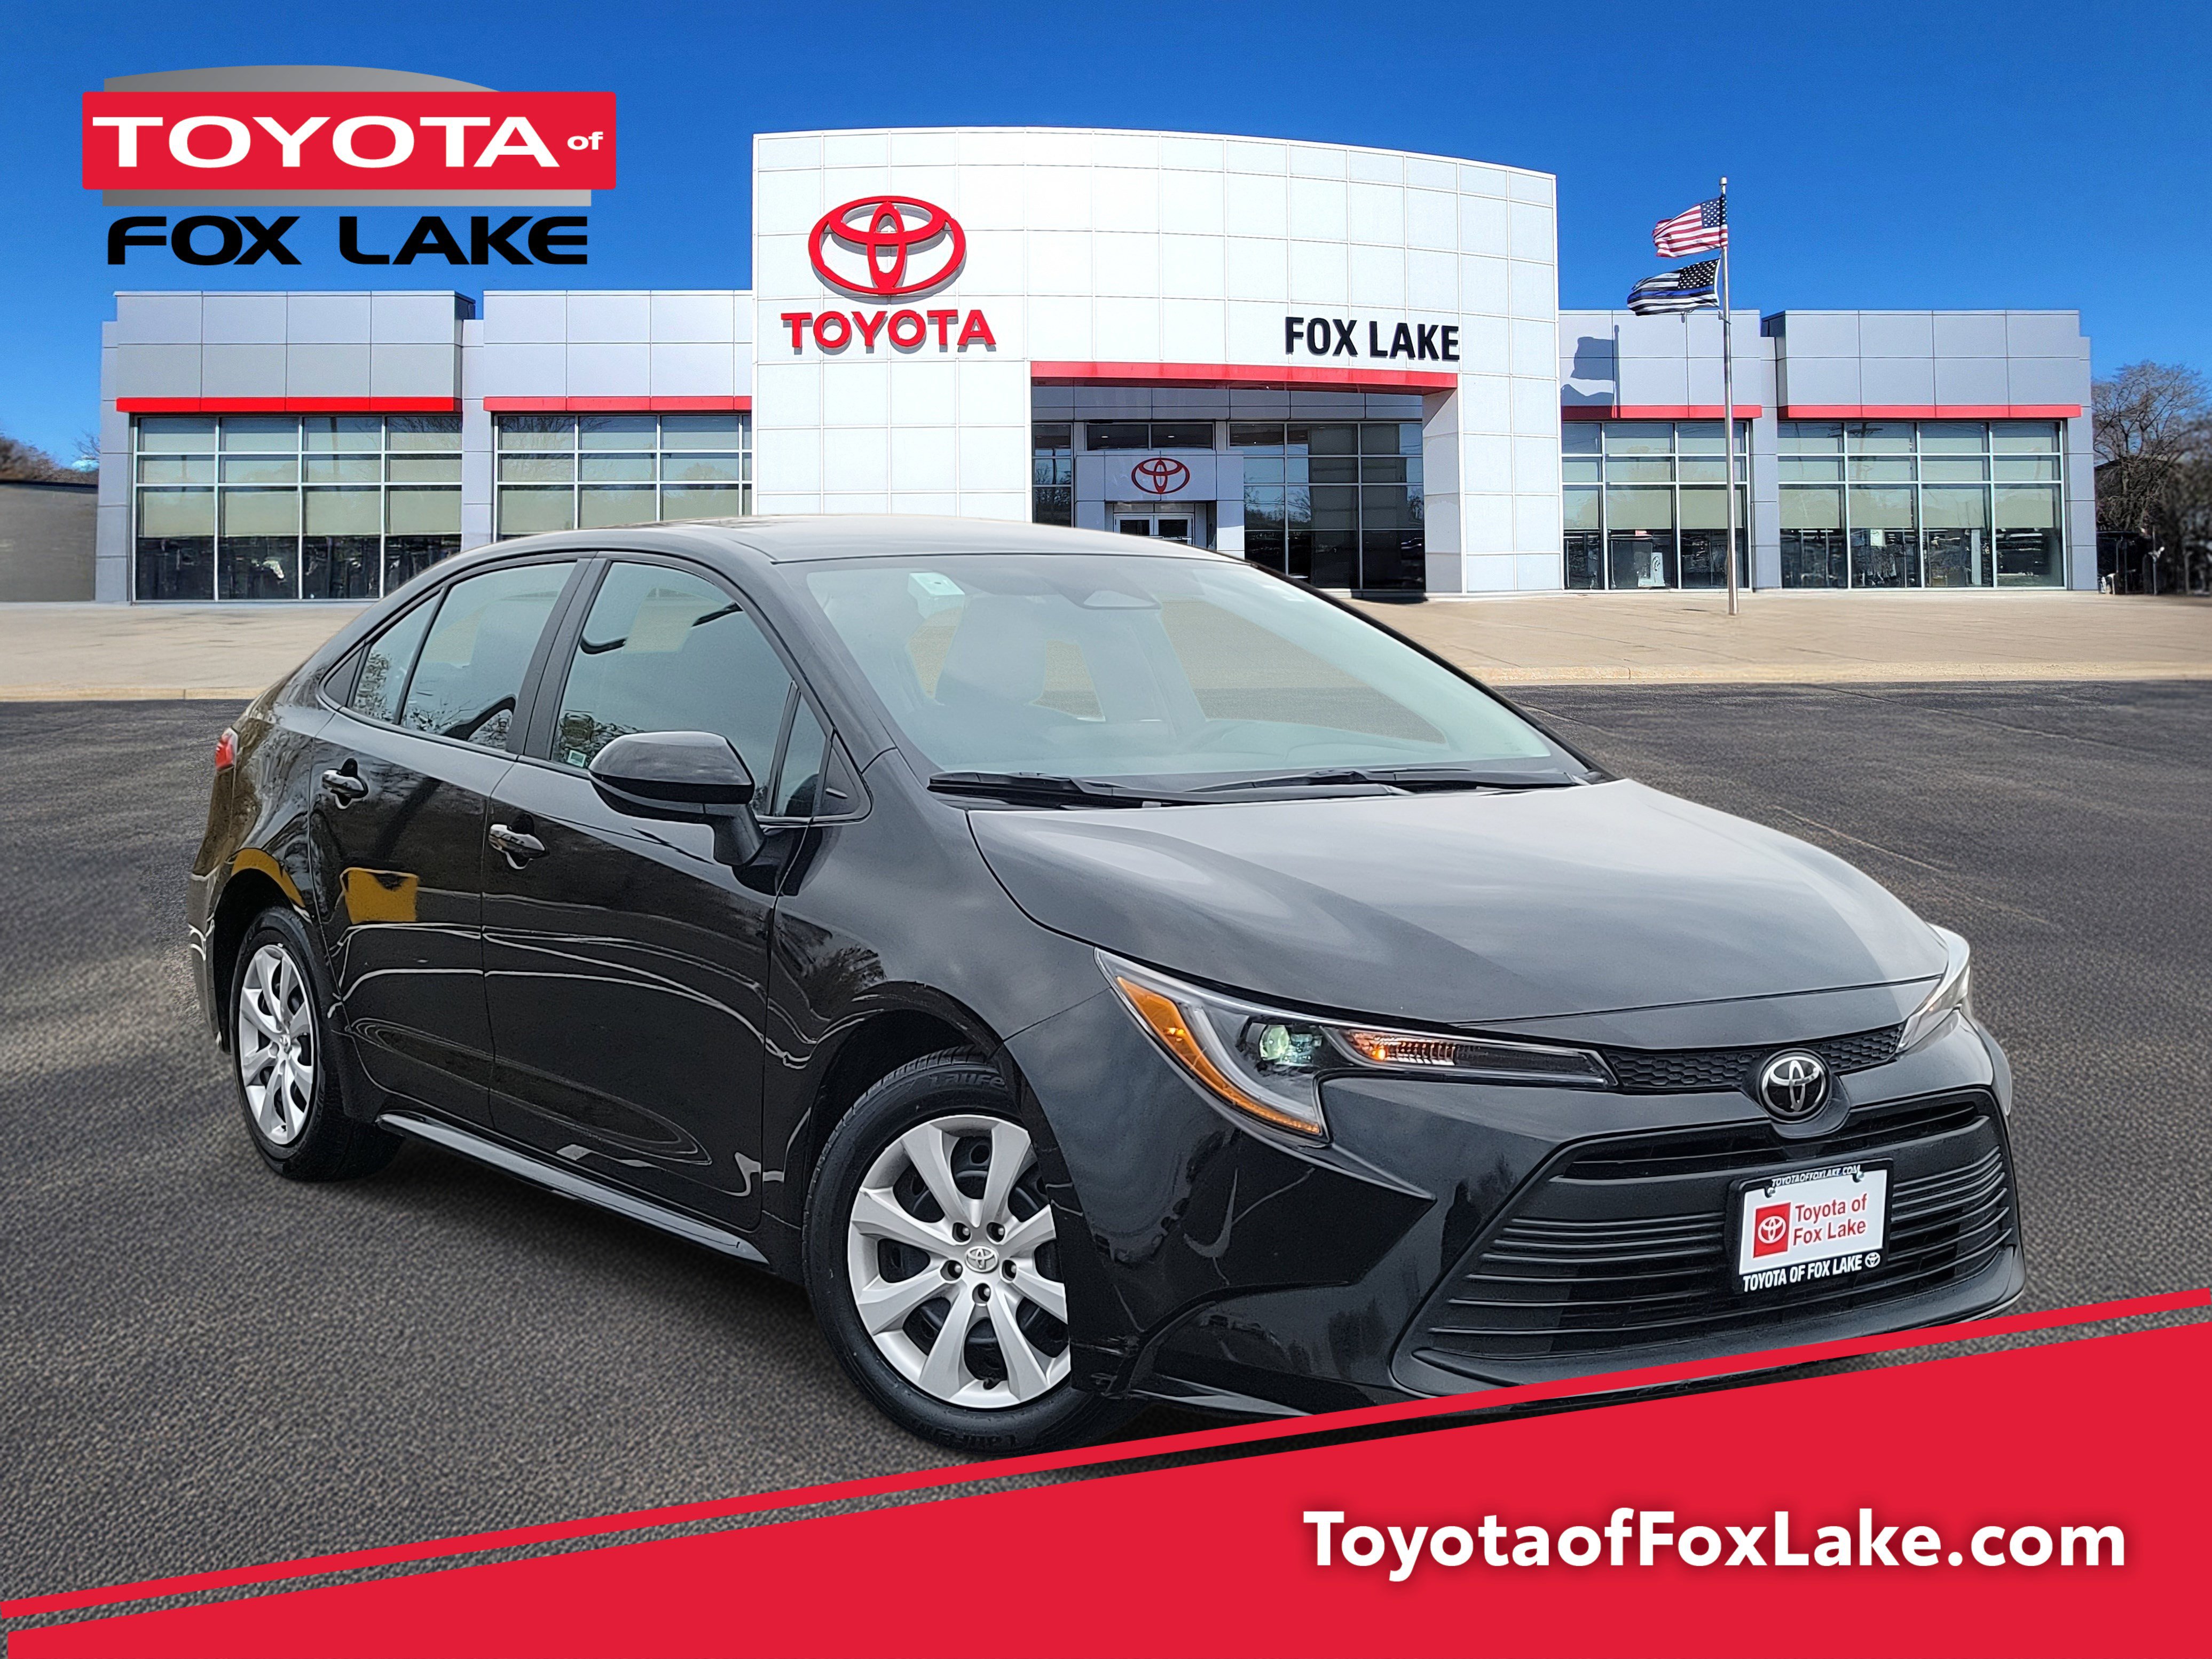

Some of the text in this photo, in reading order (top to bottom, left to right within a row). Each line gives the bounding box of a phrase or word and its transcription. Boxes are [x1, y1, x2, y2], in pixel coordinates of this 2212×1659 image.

[781, 309, 996, 349] TOYOTA
[1285, 316, 1460, 361] FOX LAKE
[1795, 1193, 1868, 1224] Toyota of
[1793, 1218, 1866, 1246] Fox Lake
[1743, 1254, 1862, 1292] TOYOTA OF FOX LAKE
